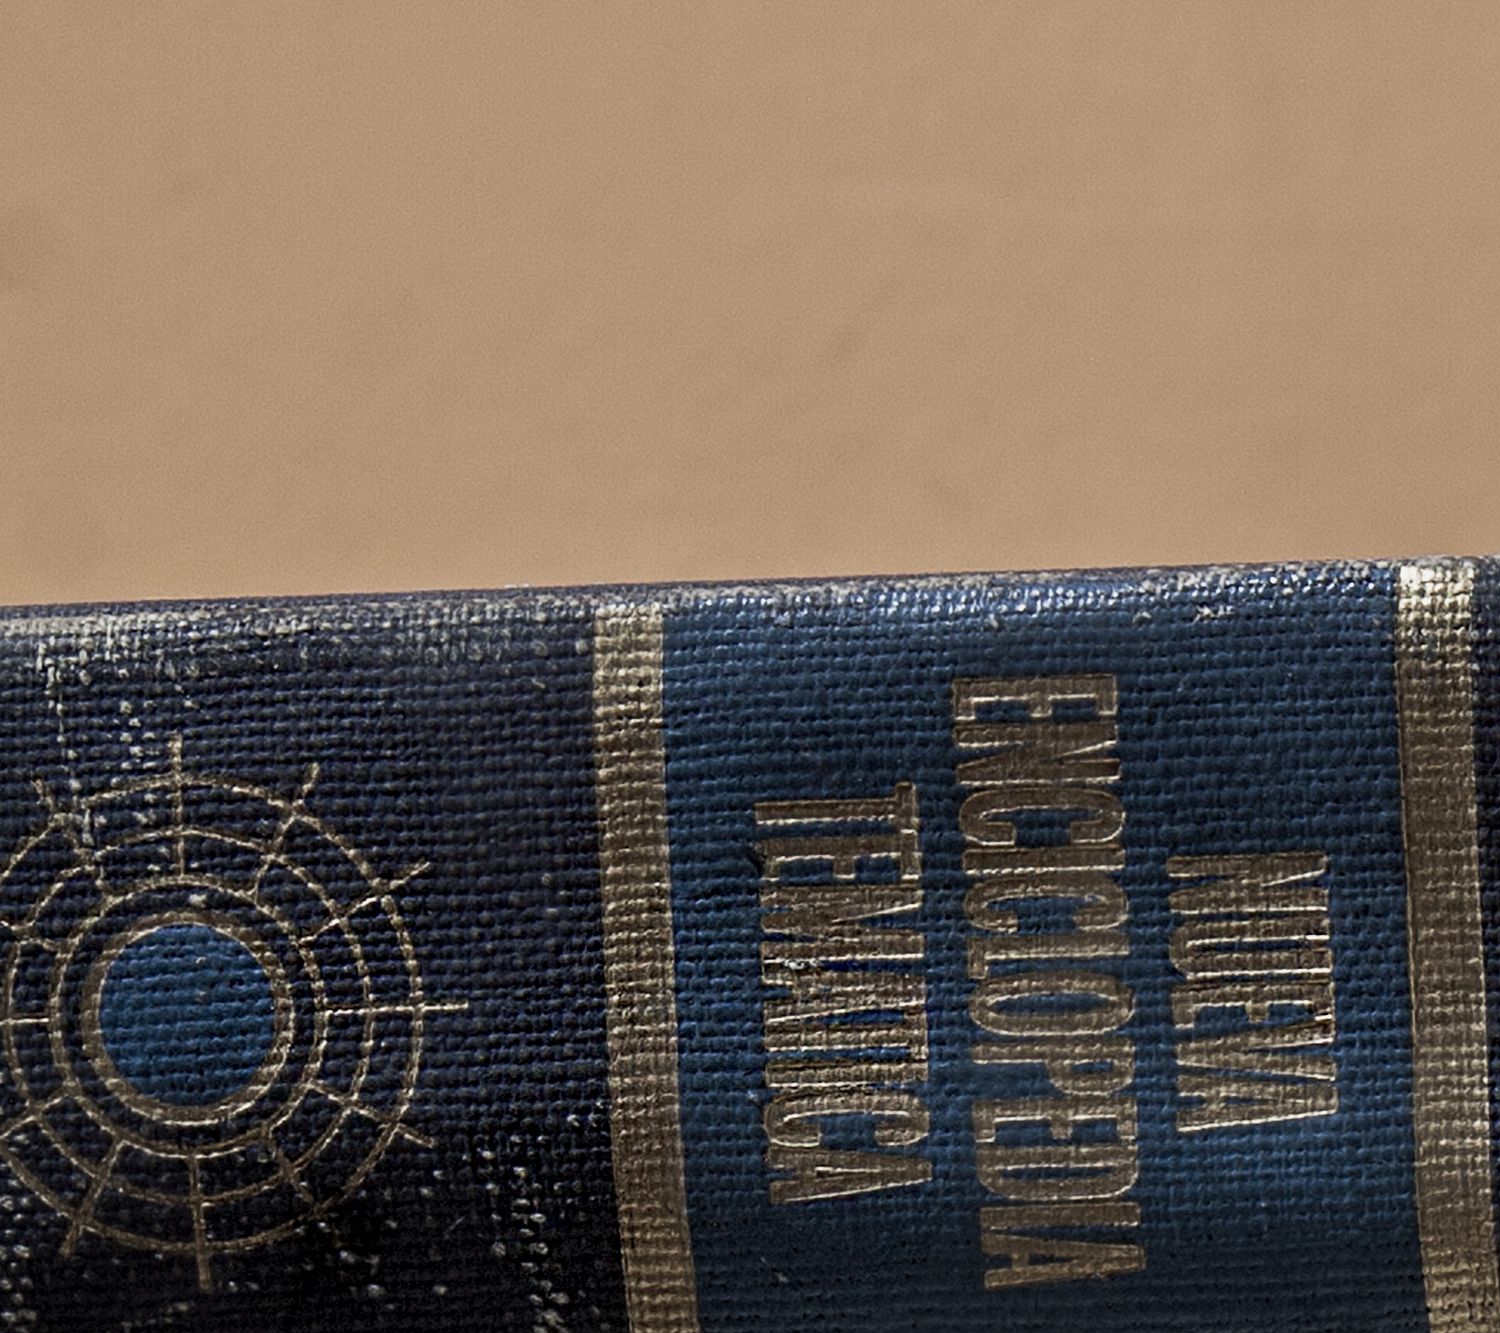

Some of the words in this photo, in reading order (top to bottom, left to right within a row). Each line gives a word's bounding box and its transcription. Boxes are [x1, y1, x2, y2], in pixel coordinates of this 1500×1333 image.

[753, 783, 930, 1202] TEMATICA
[953, 676, 1144, 1288] ENCICLOPEDIA
[1170, 851, 1337, 1129] NUEVA
